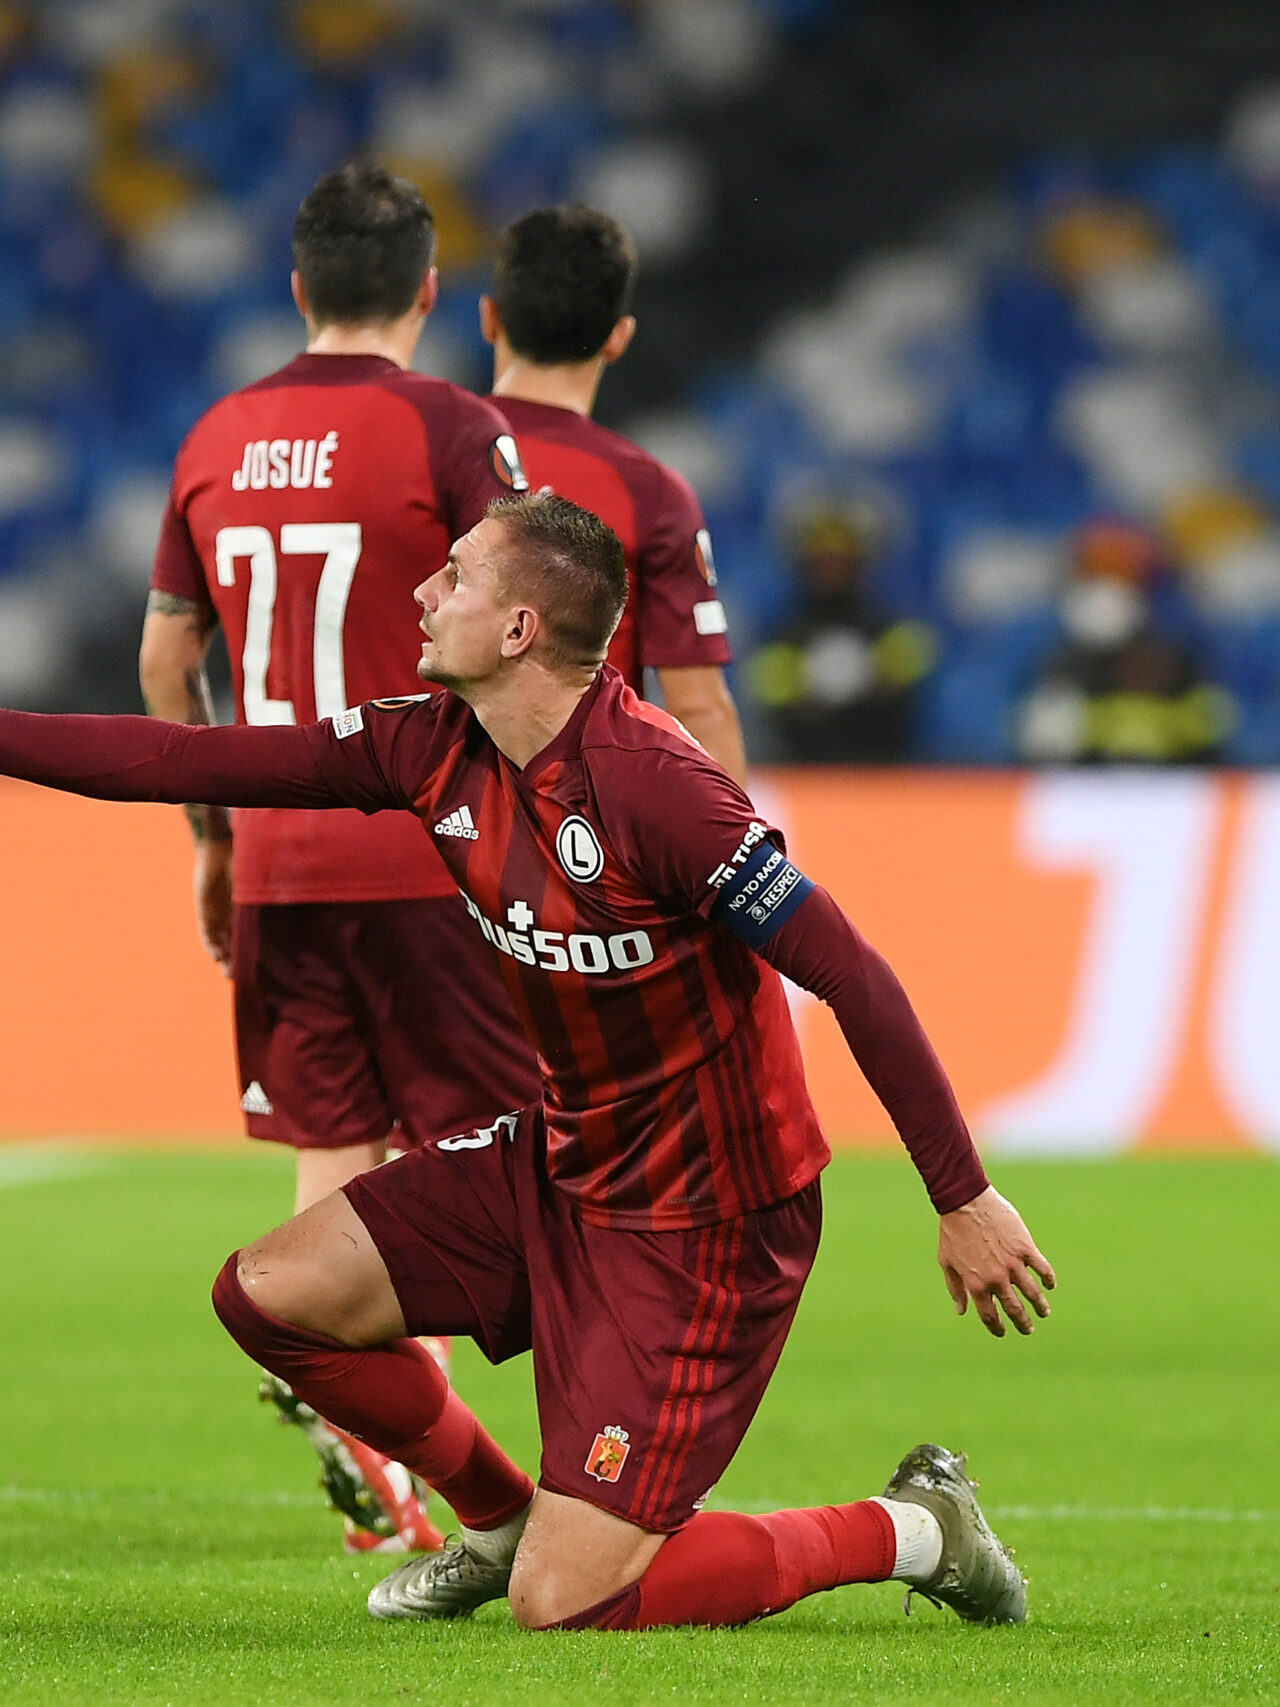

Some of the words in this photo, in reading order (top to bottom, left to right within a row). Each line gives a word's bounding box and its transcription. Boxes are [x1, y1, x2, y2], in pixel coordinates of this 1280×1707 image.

[232, 430, 339, 491] JOSUÉ
[215, 522, 362, 726] 27
[434, 823, 480, 841] adidas
[728, 894, 746, 912] NO
[742, 880, 759, 896] TO
[762, 866, 798, 908] RESPECT
